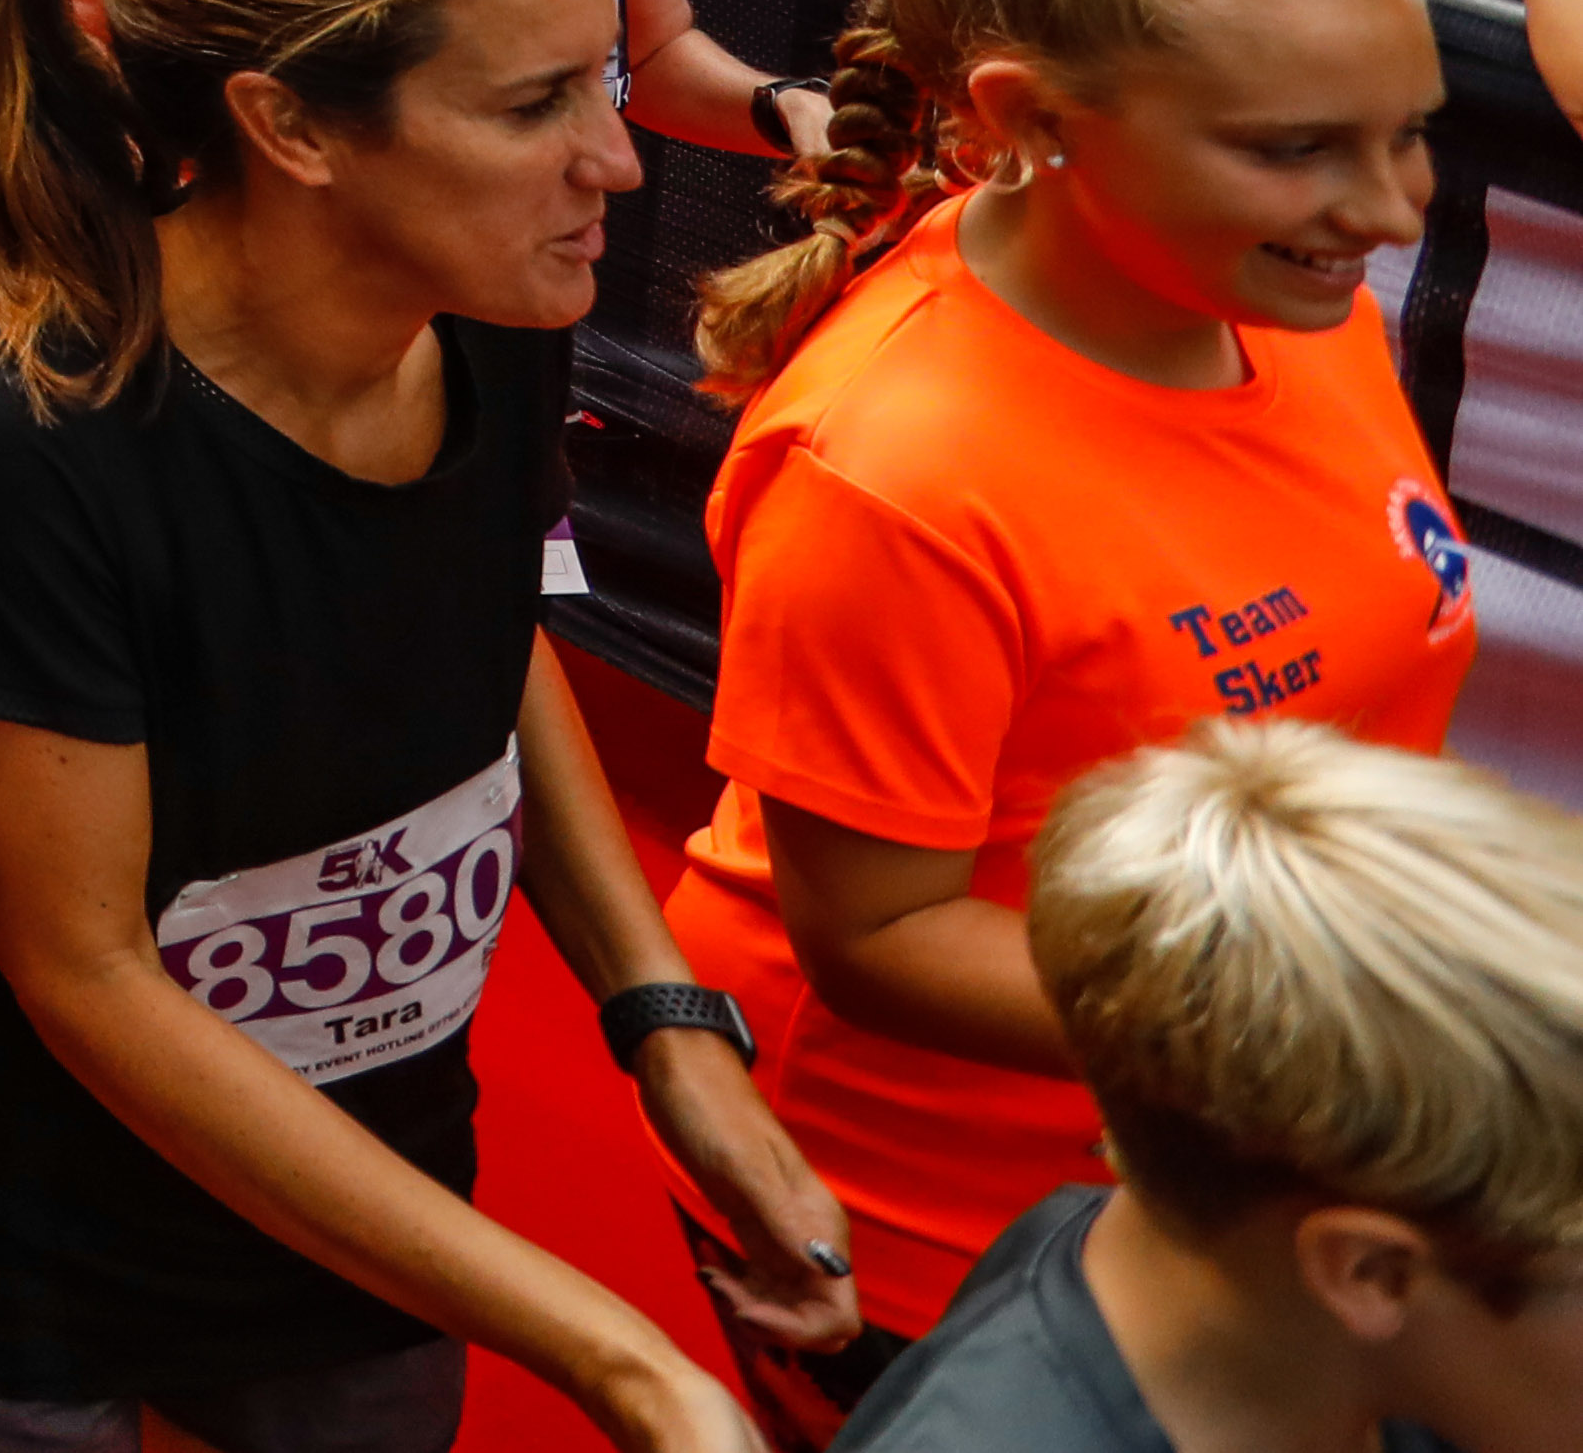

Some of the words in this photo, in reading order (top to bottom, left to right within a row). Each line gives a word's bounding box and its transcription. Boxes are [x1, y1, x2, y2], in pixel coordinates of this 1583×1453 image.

[1169, 586, 1308, 658] Team
[1214, 648, 1321, 716] Sker
[317, 827, 415, 892] 5K
[186, 827, 514, 1024] 8580
[314, 1051, 362, 1074] EVENT
[365, 1029, 425, 1056] HOTLINE
[324, 1000, 423, 1045] Tara
